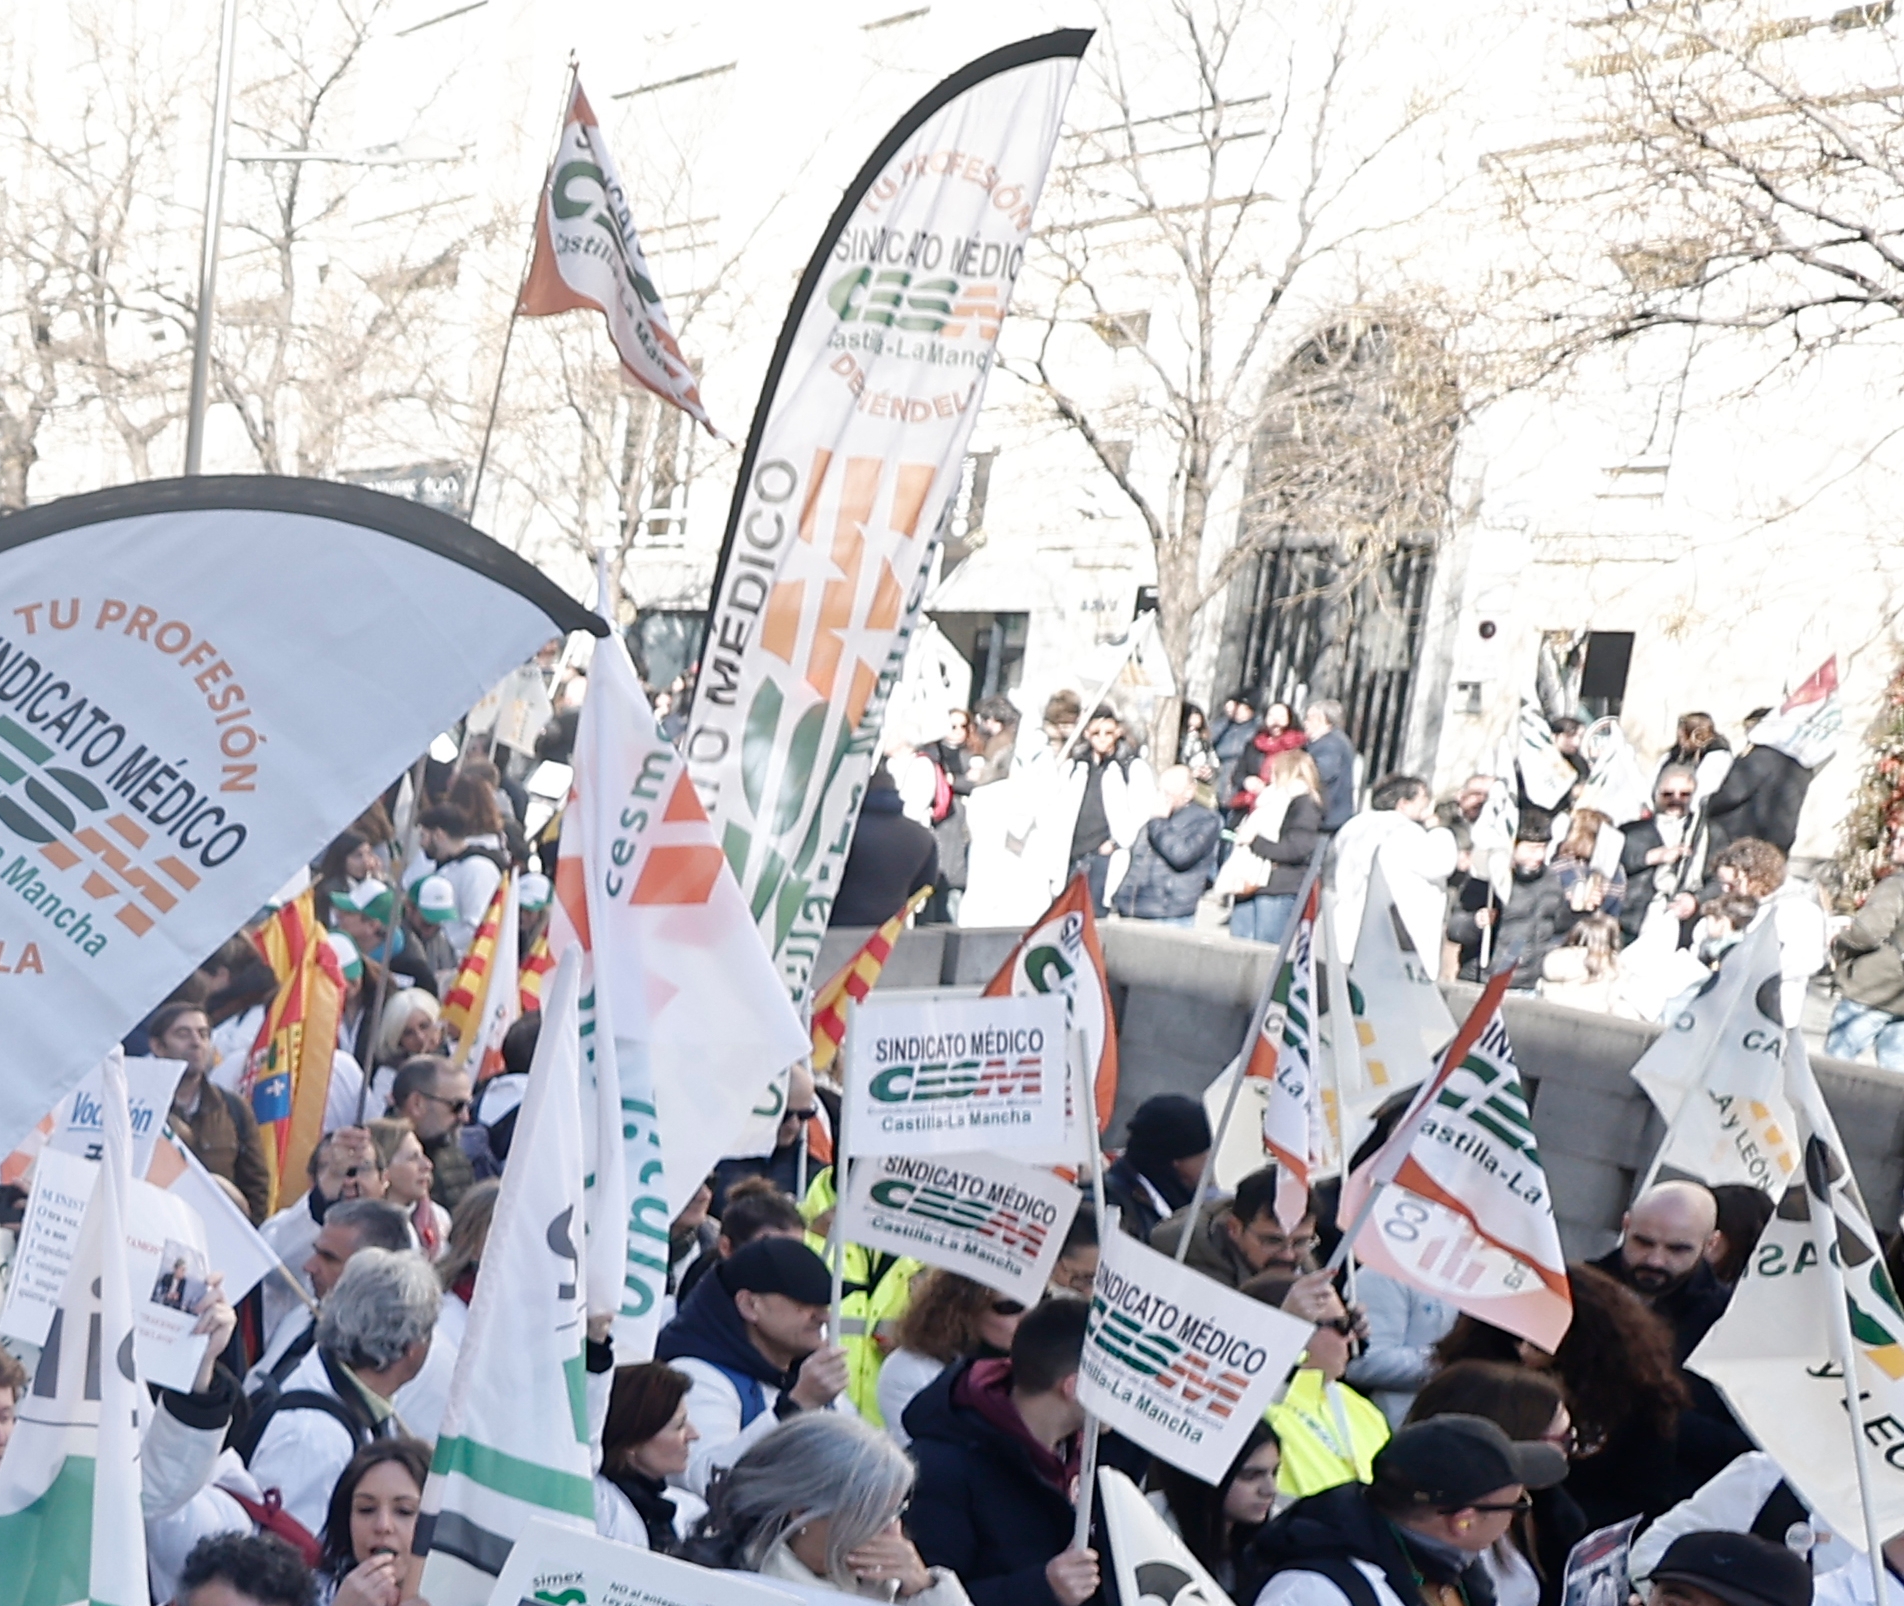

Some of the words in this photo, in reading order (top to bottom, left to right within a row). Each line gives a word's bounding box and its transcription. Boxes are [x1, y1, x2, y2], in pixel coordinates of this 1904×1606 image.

[863, 178, 899, 214] TU
[902, 149, 1034, 232] PROFESIÓN
[949, 231, 1025, 283] MÉDIC
[699, 457, 798, 708] MÉDICO
[12, 597, 80, 634] TU
[94, 599, 267, 792] PROFESIÓN
[104, 745, 248, 868] MÉDICO
[876, 1033, 966, 1063] SINDICATO
[971, 1023, 1045, 1056] MÉDICO
[868, 1057, 1042, 1103] CESM
[969, 1108, 1032, 1126] Mancha
[884, 1155, 985, 1198] SINDICATO
[987, 1181, 1058, 1226] MÉDICO
[870, 1179, 1048, 1259] CESM
[964, 1242, 1023, 1277] Mancha
[1177, 1314, 1268, 1375] MÉDICO
[1136, 1397, 1204, 1444] Mancha
[532, 1569, 585, 1588] simex
[610, 1582, 630, 1595] NO
[631, 1587, 642, 1600] al
